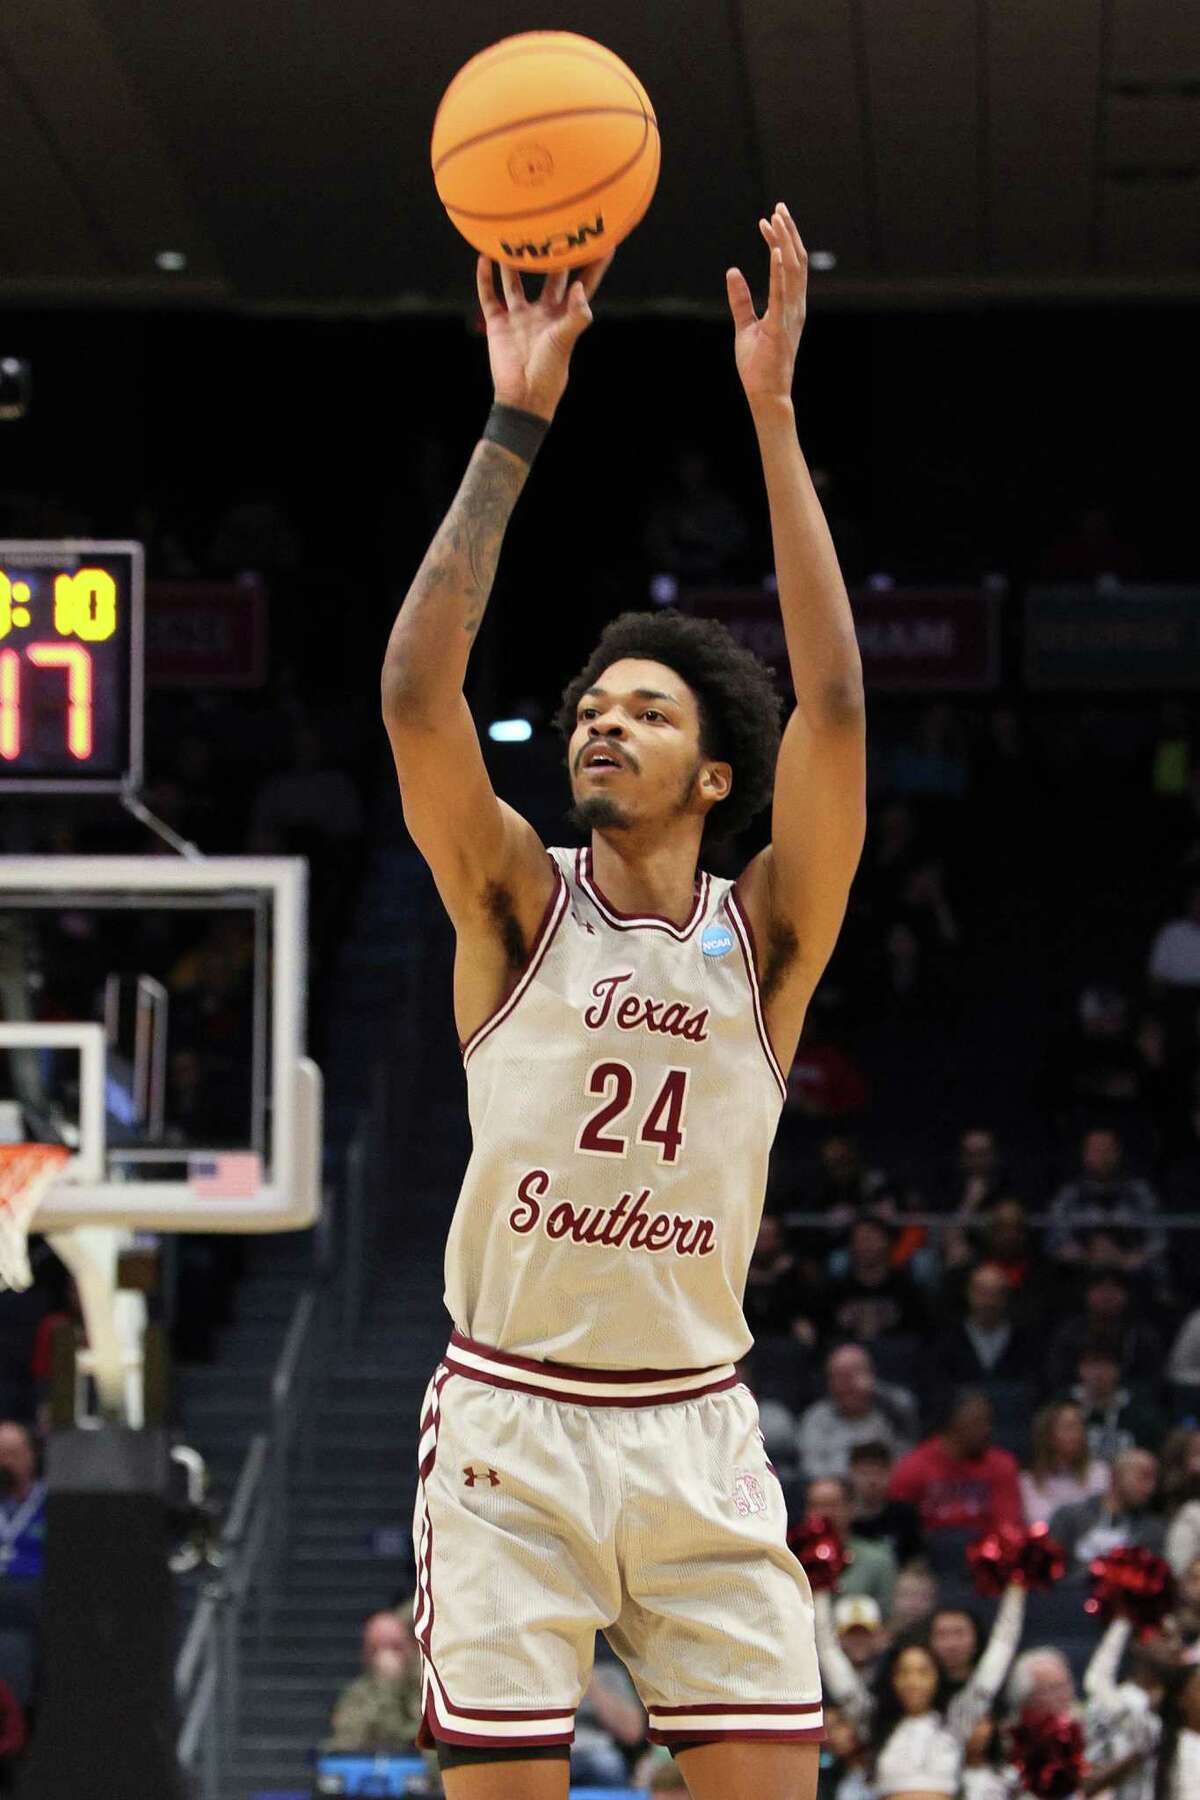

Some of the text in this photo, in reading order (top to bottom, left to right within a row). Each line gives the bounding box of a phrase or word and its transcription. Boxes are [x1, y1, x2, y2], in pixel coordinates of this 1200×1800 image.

[702, 937, 732, 951] NCAA
[584, 972, 709, 1043] Texas
[576, 1058, 691, 1166] 24
[508, 1168, 716, 1257] Southern
